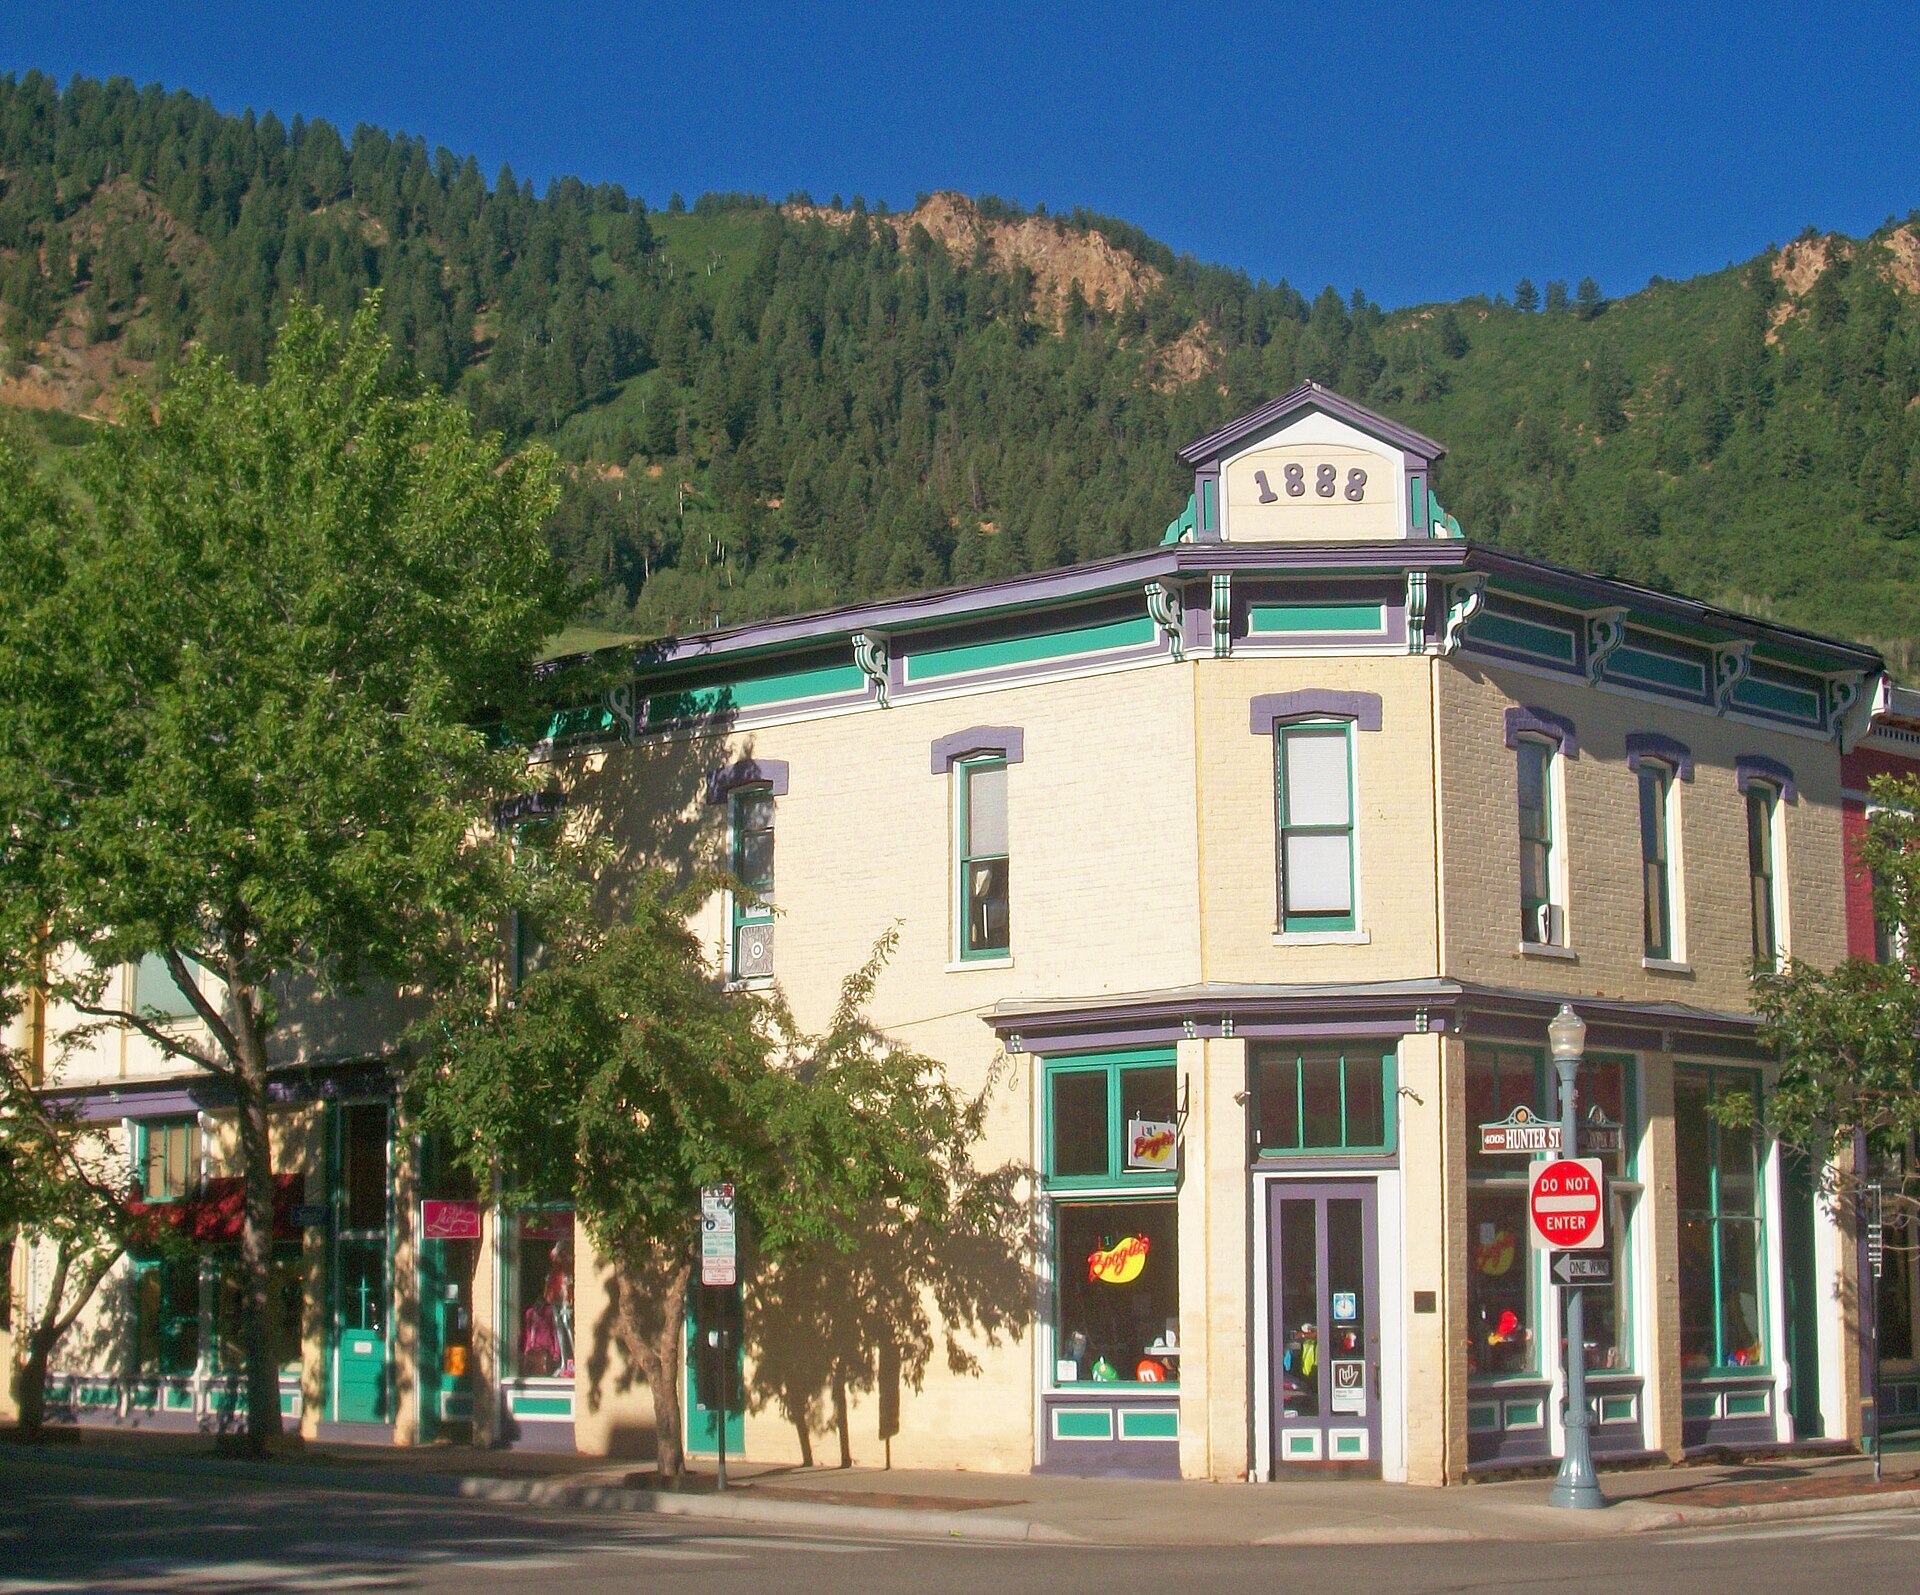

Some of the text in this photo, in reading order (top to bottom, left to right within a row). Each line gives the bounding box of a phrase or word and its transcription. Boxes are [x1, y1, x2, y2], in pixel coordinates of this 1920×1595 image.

[1254, 463, 1367, 504] 1888
[1506, 1128, 1547, 1149] HUNTER
[1548, 1128, 1560, 1148] ST
[1541, 1177, 1590, 1192] DO NOT
[1547, 1216, 1586, 1230] ENTER
[1570, 1261, 1587, 1274] ONE
